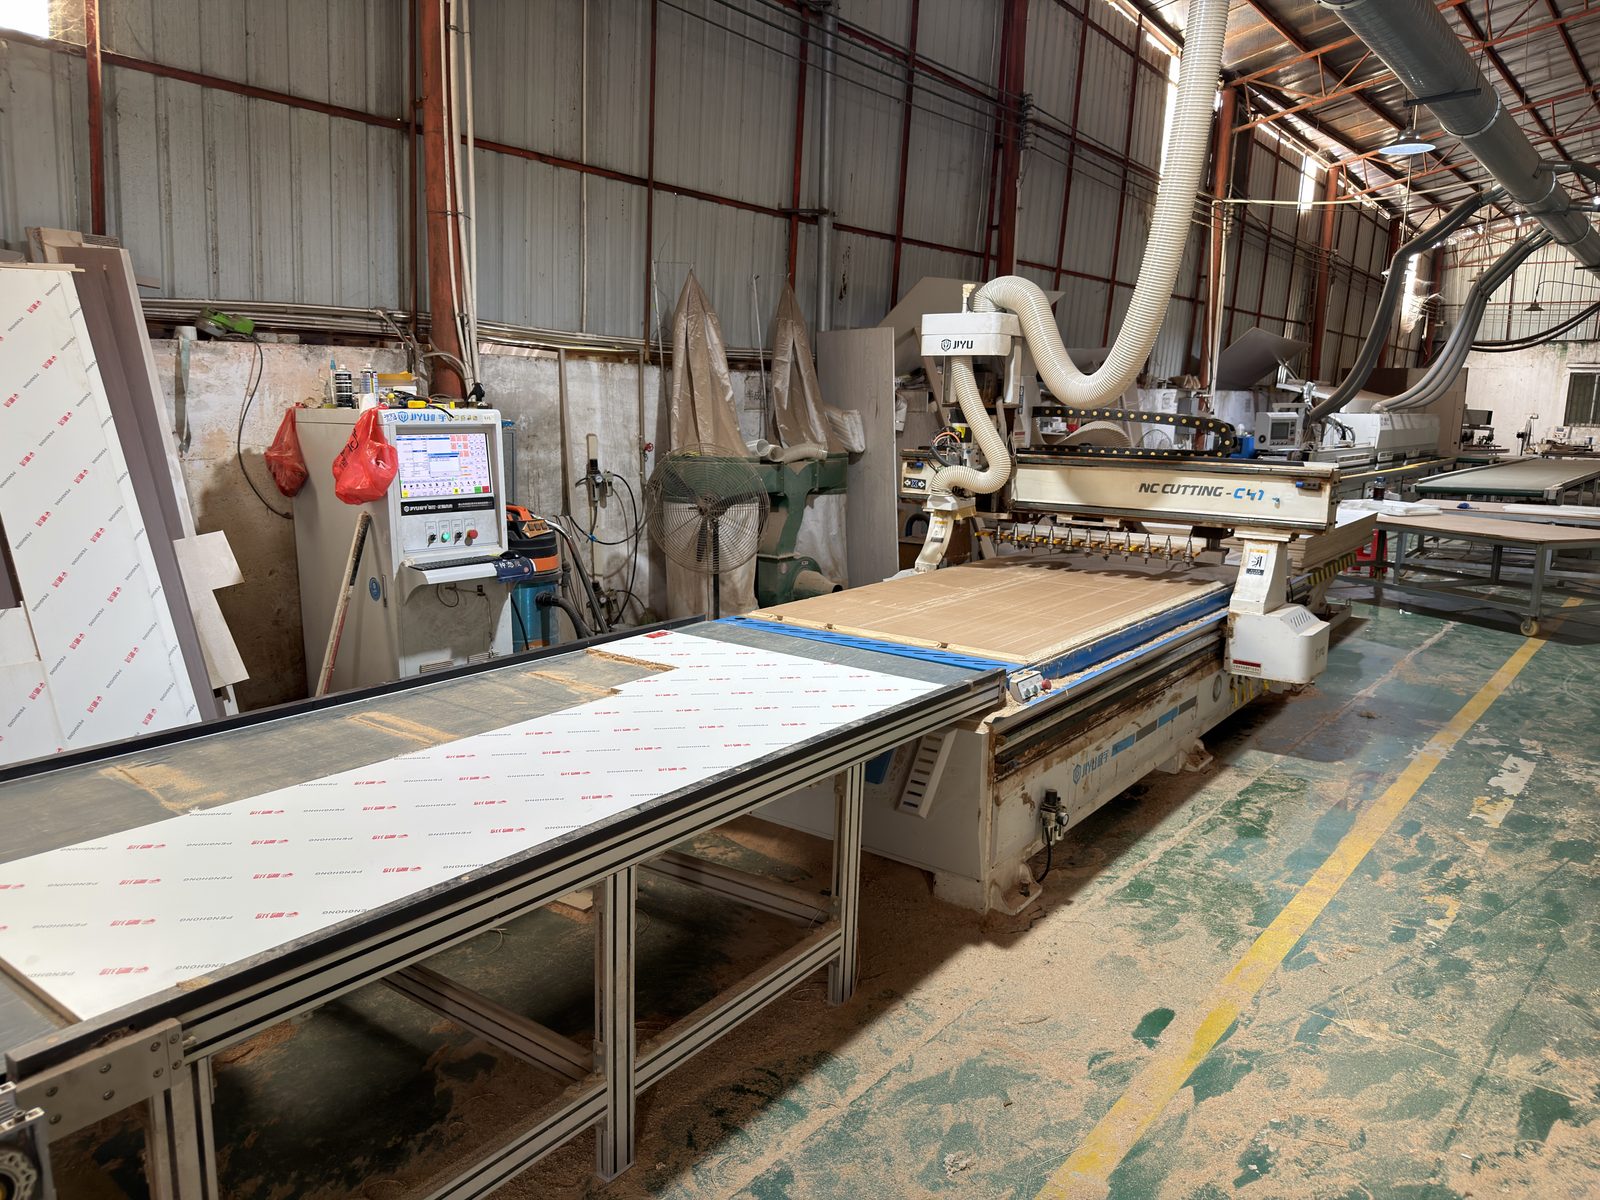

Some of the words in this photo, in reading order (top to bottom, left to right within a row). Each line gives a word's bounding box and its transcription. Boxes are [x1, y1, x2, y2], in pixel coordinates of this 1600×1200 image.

[953, 340, 974, 349] JIYU
[1139, 483, 1160, 493] NC
[1162, 484, 1224, 497] CUTTING
